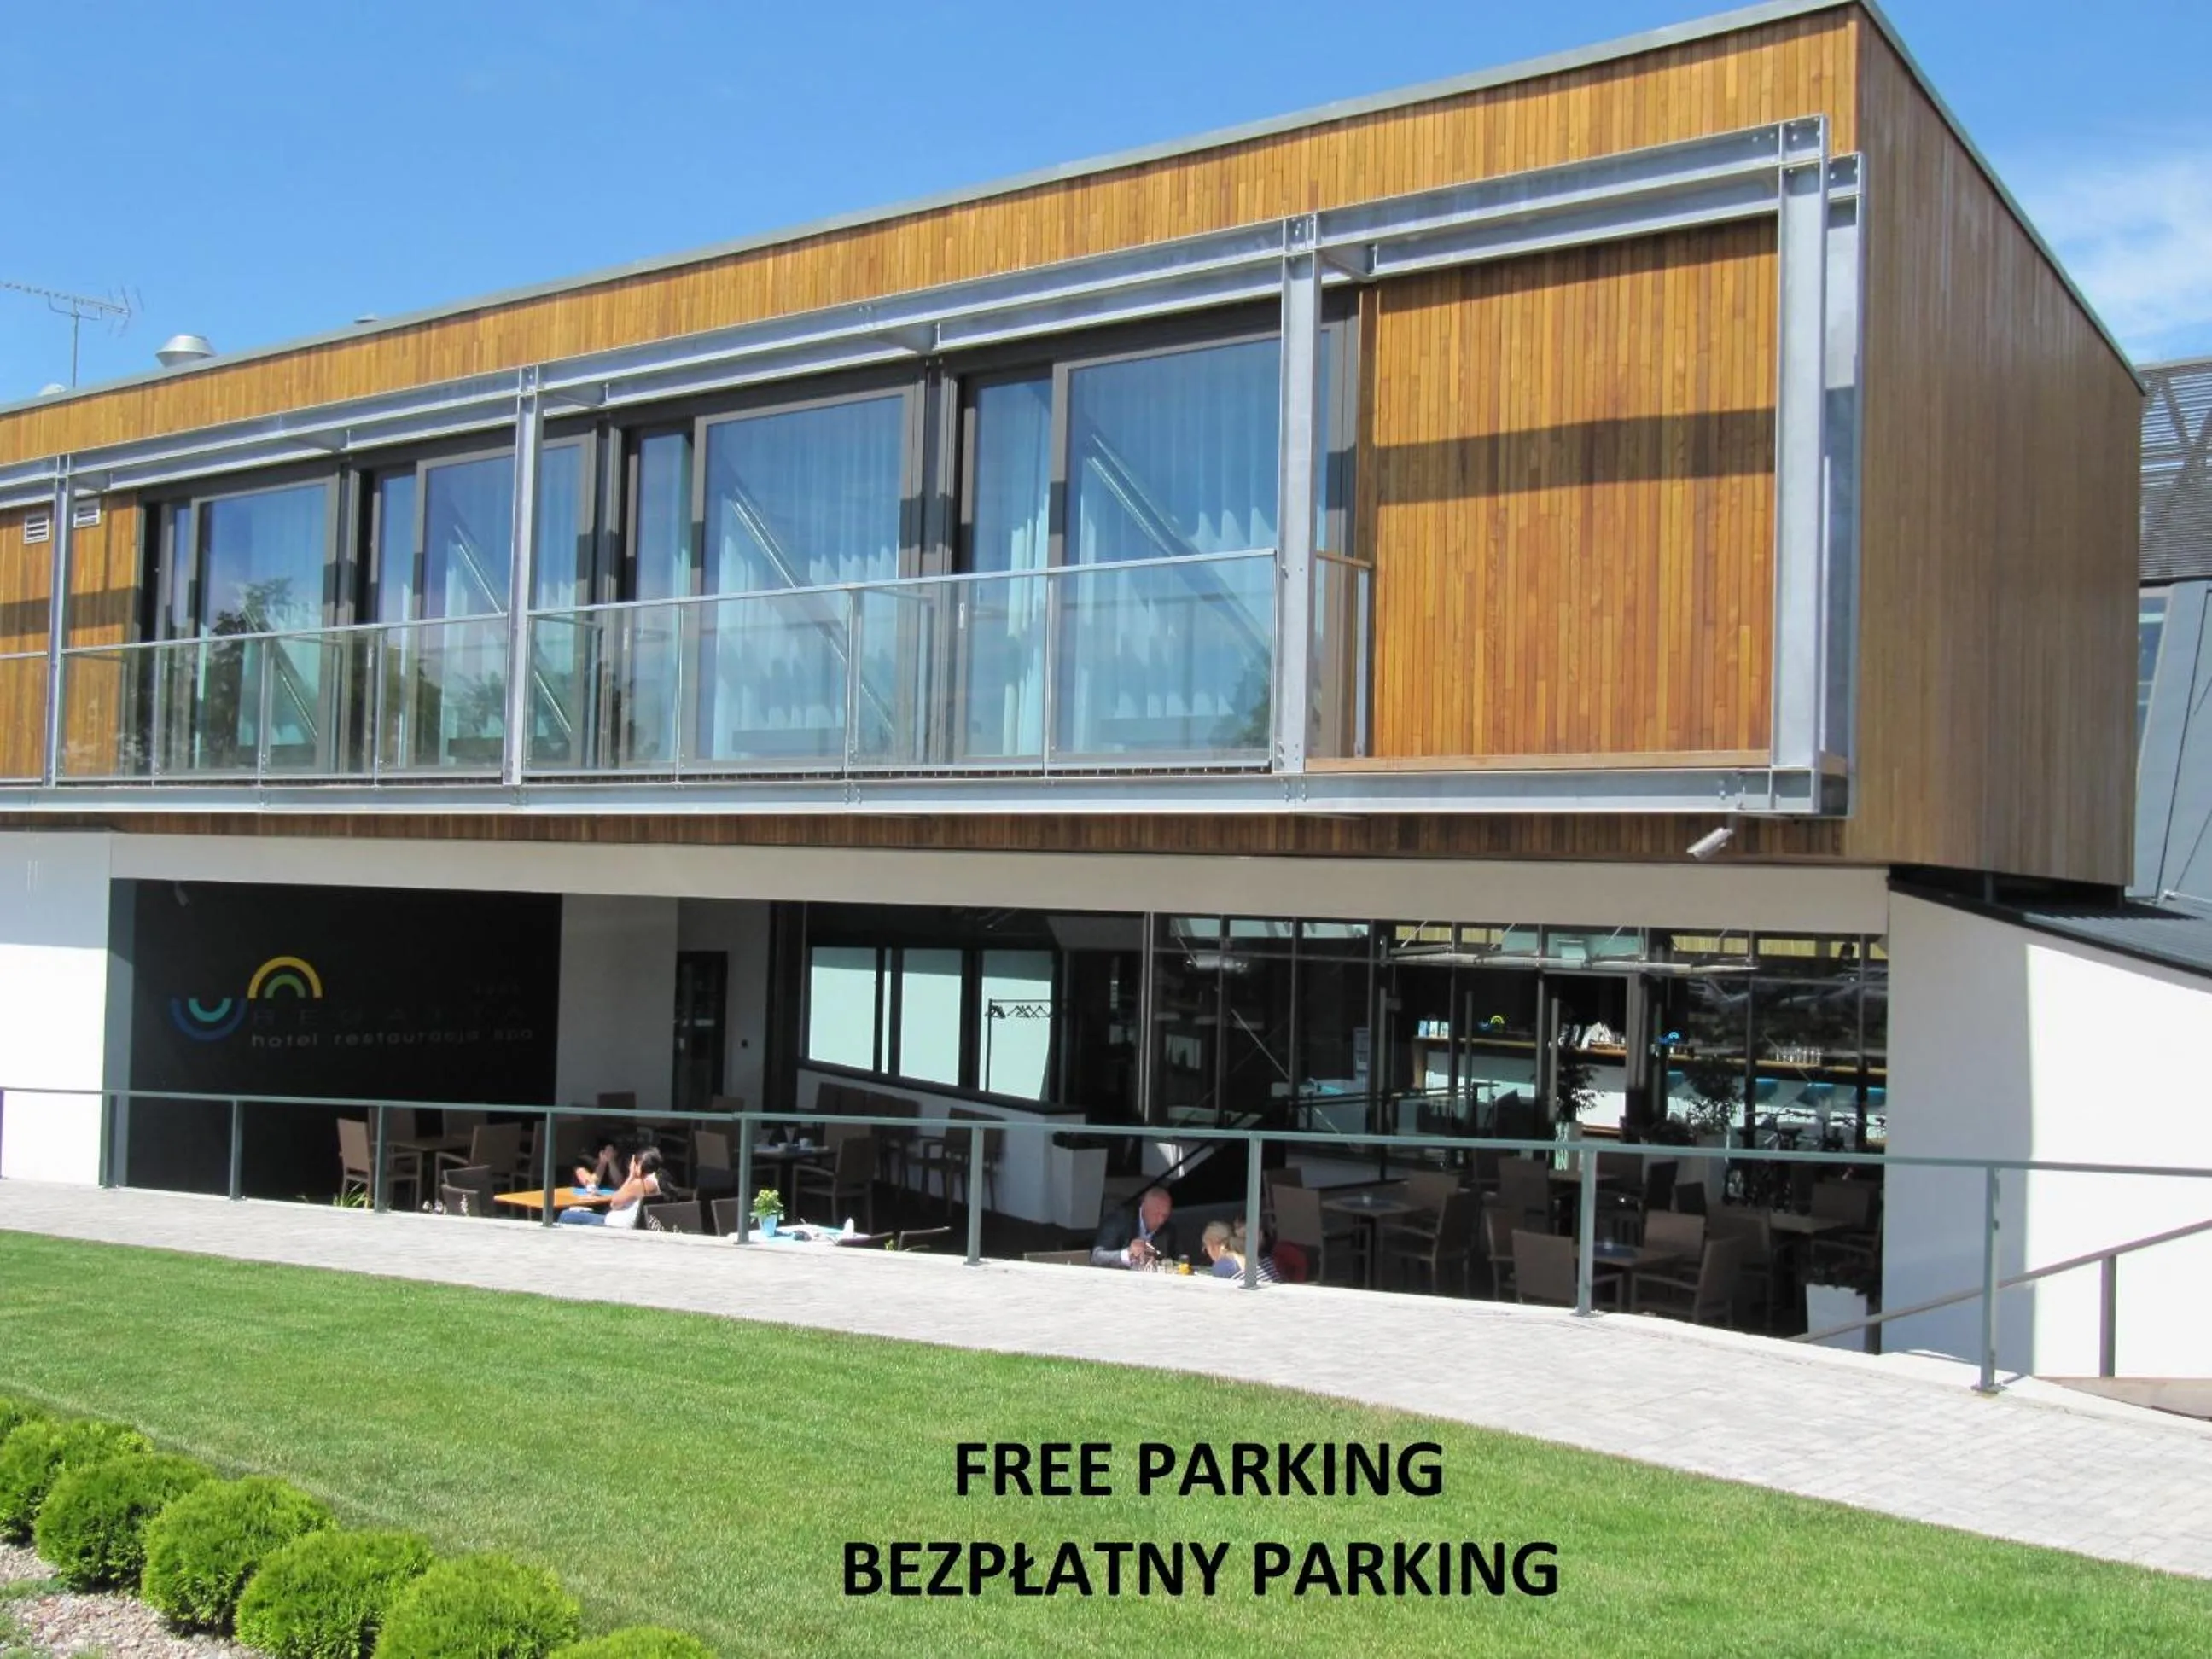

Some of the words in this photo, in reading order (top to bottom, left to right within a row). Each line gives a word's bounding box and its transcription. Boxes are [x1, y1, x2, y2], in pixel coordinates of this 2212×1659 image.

[251, 1033, 319, 1049] hotel
[334, 1029, 480, 1048] restauracja
[493, 1027, 534, 1043] spa
